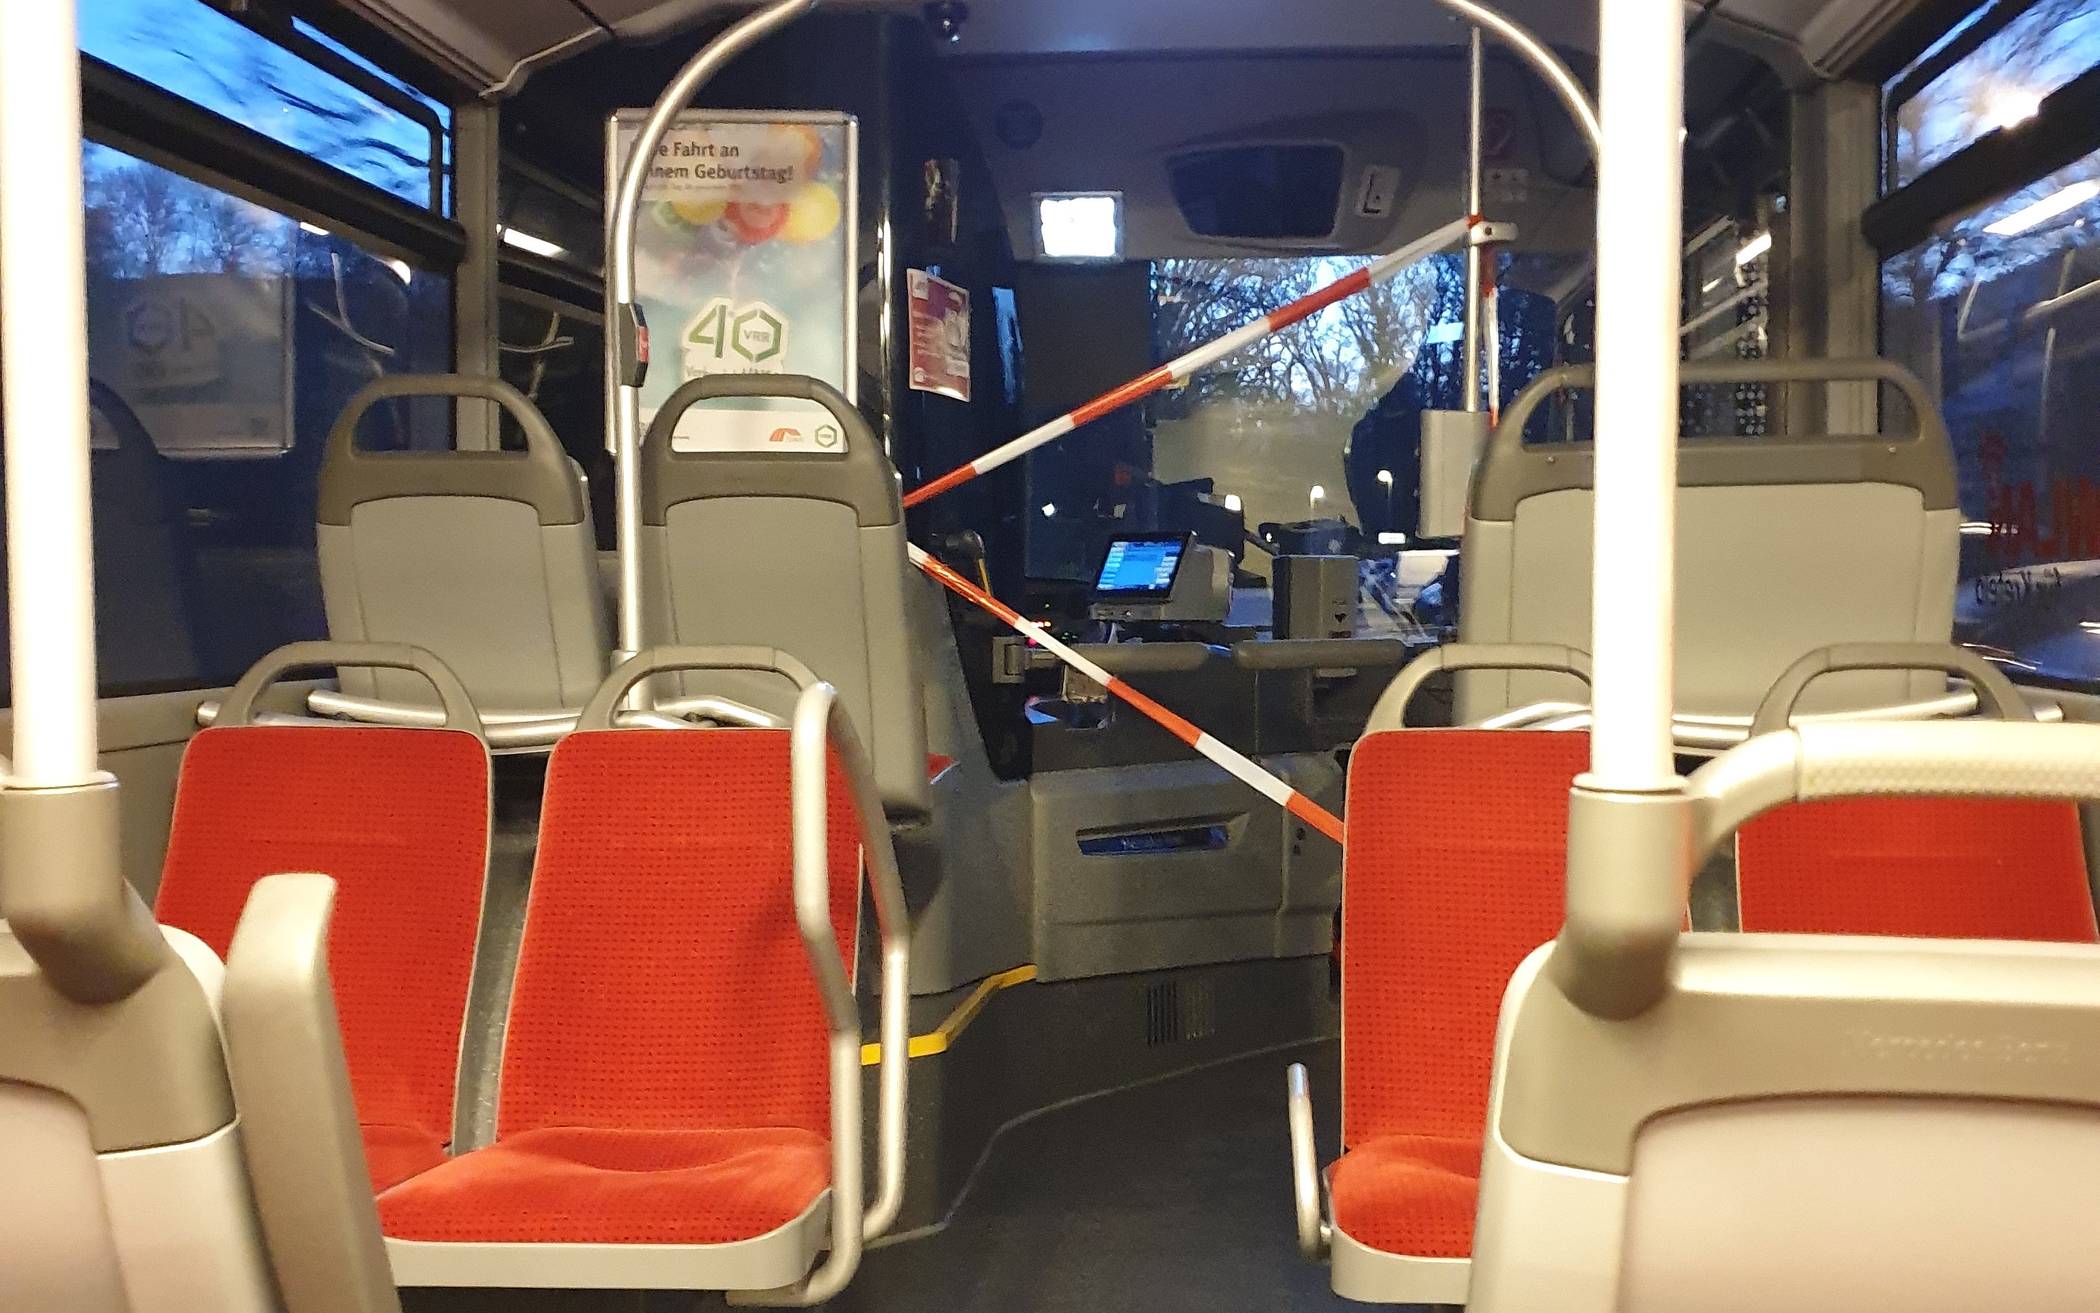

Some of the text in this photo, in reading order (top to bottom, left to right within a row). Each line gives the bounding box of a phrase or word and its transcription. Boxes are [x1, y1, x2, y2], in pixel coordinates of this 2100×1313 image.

[673, 141, 715, 157] Fahrt
[720, 145, 739, 157] an
[694, 163, 794, 184] Geburtstag!
